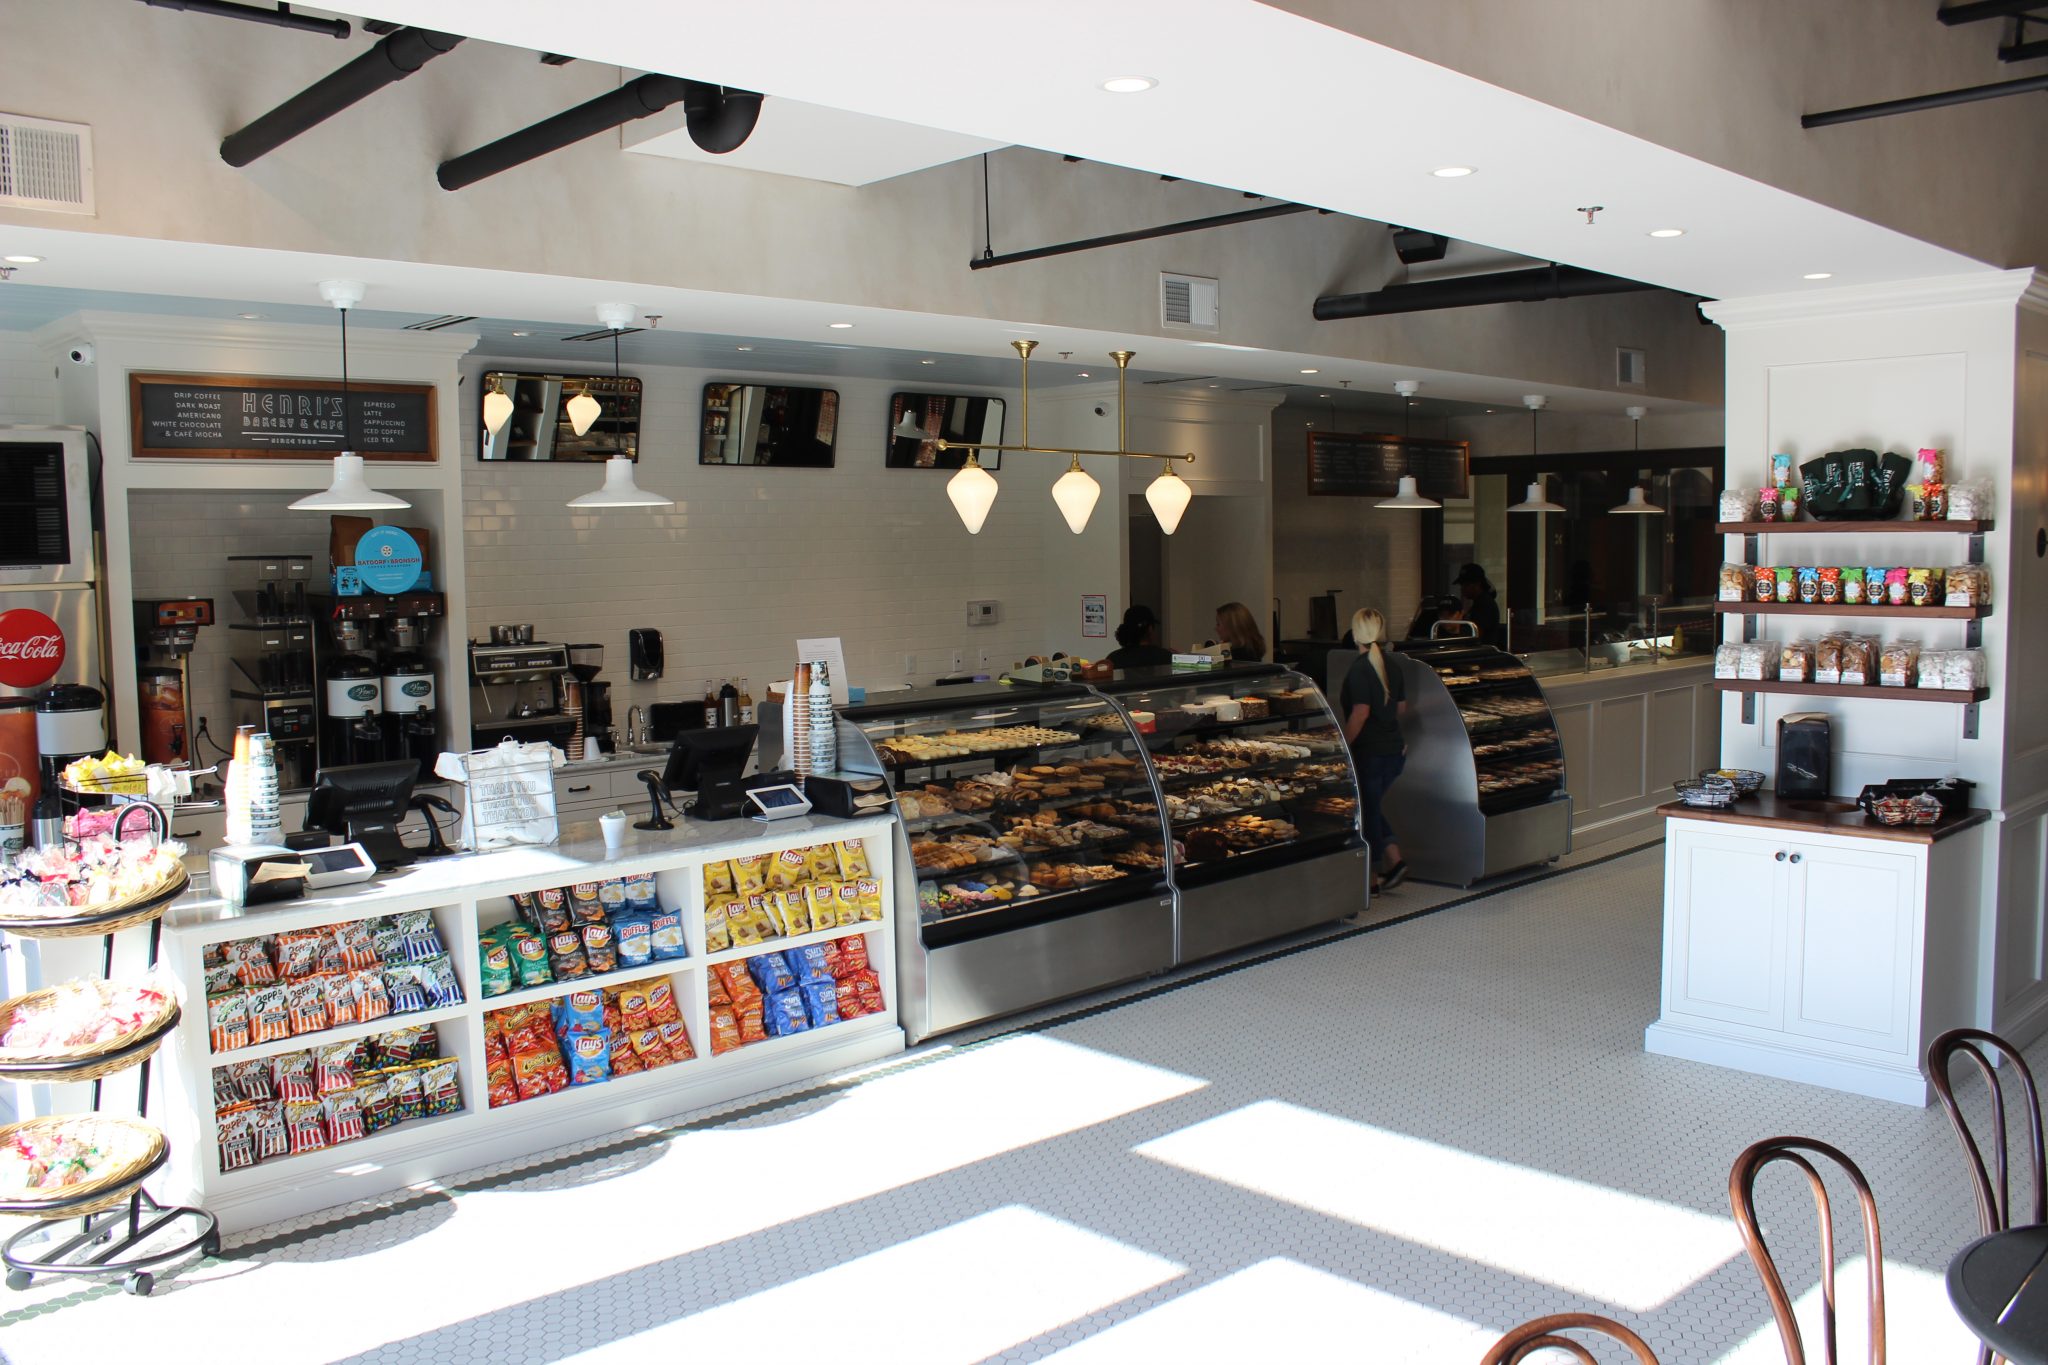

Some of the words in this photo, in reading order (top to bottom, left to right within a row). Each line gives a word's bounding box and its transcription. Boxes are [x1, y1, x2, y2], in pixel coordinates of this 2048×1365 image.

[242, 392, 343, 417] HENRI'S
[363, 401, 396, 409] ESPRESSO
[179, 421, 222, 429] CHOCOLATE
[243, 416, 295, 428] BAKERY
[363, 419, 406, 427] CAPPUCCINO
